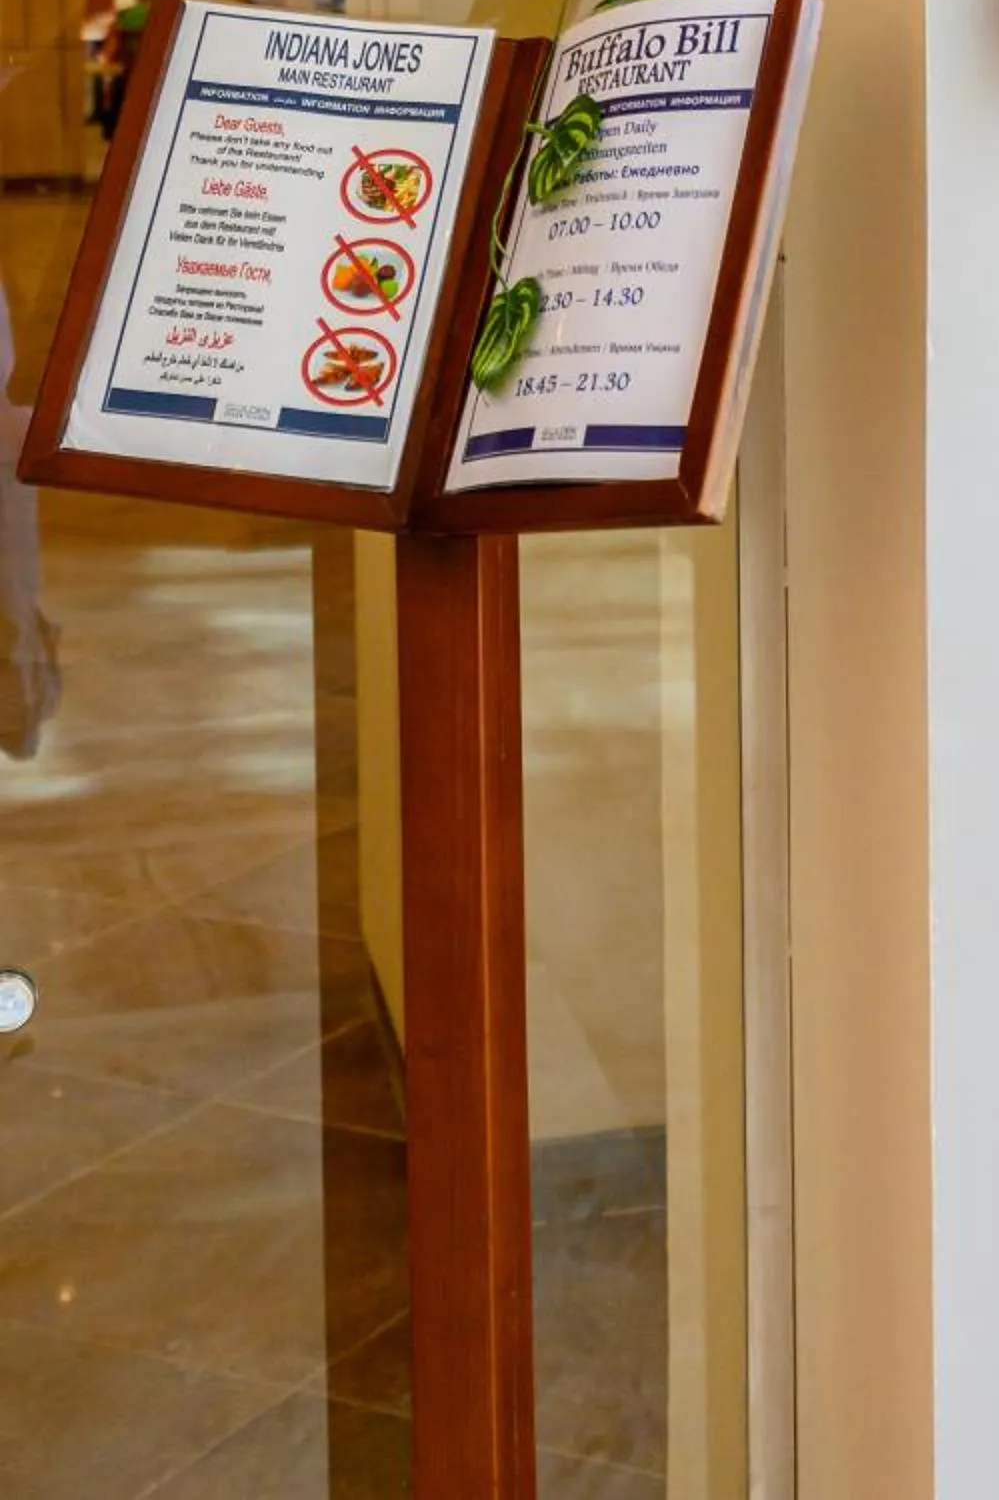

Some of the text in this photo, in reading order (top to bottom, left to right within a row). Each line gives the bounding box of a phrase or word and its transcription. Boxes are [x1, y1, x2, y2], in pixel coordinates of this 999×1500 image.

[264, 30, 424, 74] INDIANA JONES
[565, 20, 741, 83] Buffalo Bill
[277, 67, 396, 94] MAIN RESTAURANT
[577, 59, 692, 95] RESTAURANT
[200, 87, 269, 102] INFORMATION
[300, 98, 371, 114] INFORMATION
[373, 105, 446, 119] ИНФОРМАЦИЯ
[608, 94, 742, 113] INFORMATION ИНФОРМАЦИЯ
[213, 114, 285, 137] Dear Guests,
[623, 120, 659, 138] Daily
[293, 142, 315, 153] food
[190, 154, 218, 166] Thank
[219, 158, 239, 169] you
[239, 159, 254, 170] for
[620, 164, 701, 180] Ежедневно
[201, 178, 233, 198] Liebe
[547, 215, 591, 241] 07.00
[609, 211, 662, 232] 10.00
[175, 255, 239, 279] Уважаемые
[539, 291, 574, 313] 2.30
[592, 286, 645, 308] 14.30
[514, 374, 558, 398] 18.45
[575, 371, 632, 392] 21.30
